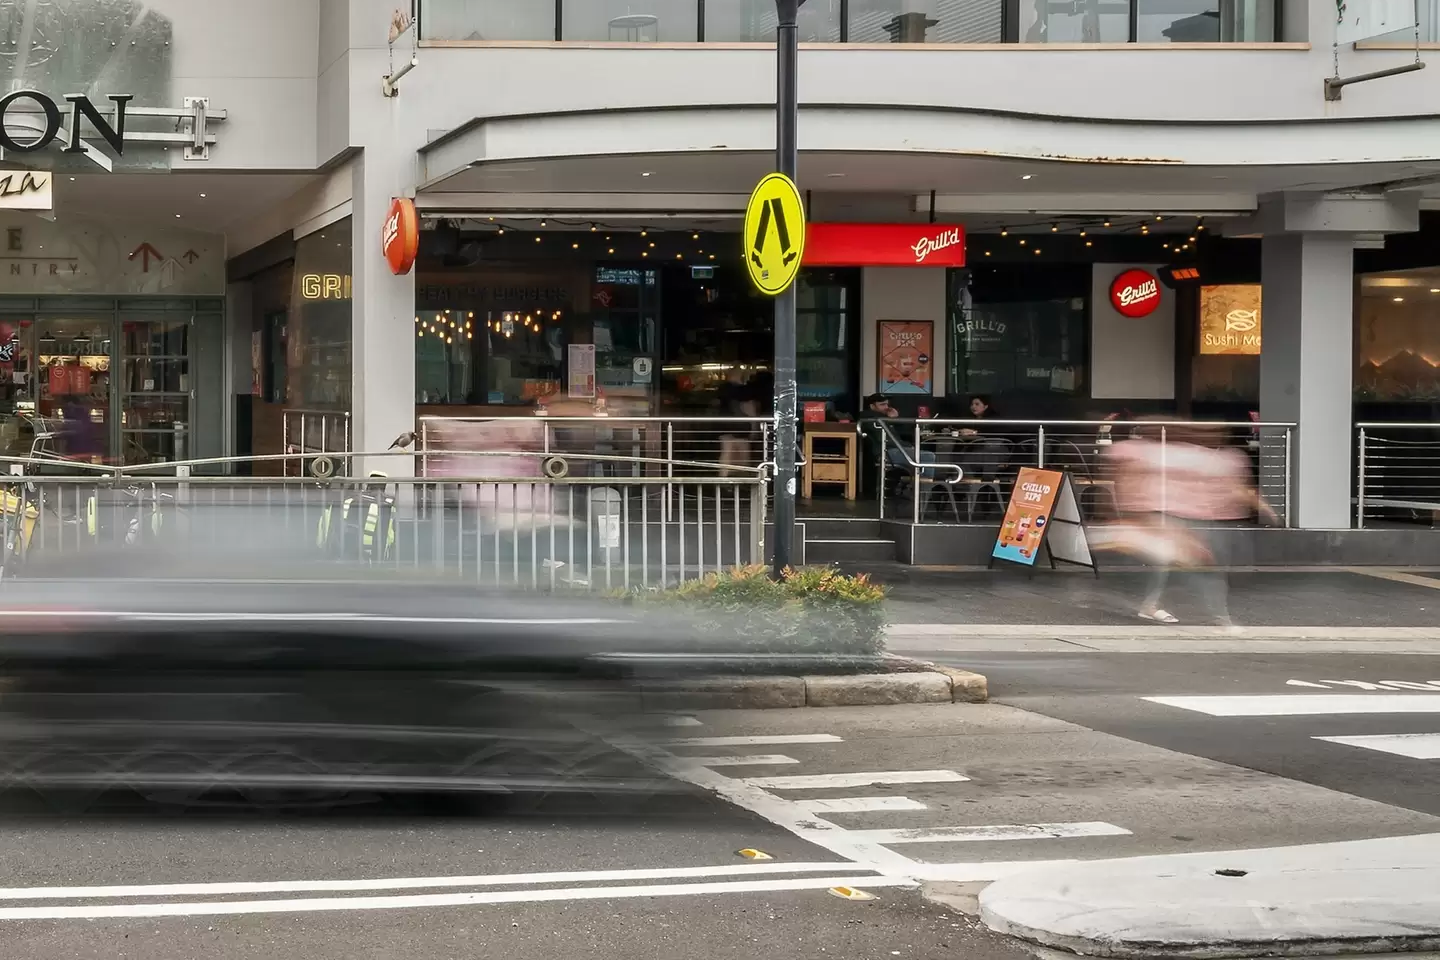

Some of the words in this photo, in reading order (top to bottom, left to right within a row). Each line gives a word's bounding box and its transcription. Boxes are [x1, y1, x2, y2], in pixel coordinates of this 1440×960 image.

[911, 228, 960, 262] Grill'd
[1116, 279, 1158, 307] Grill'd
[956, 319, 1007, 334] GRILL'D
[1205, 332, 1238, 346] Sushi
